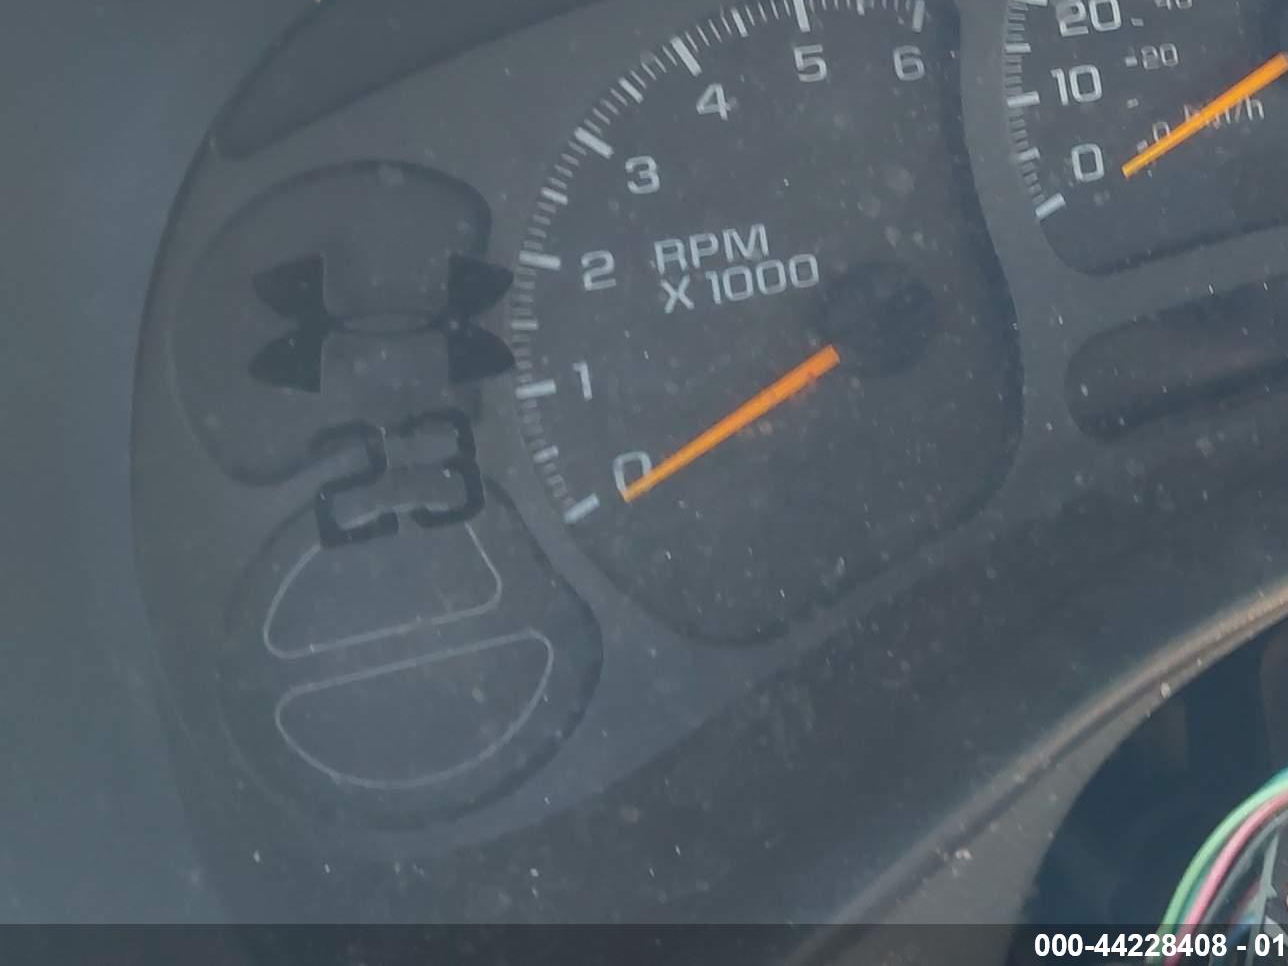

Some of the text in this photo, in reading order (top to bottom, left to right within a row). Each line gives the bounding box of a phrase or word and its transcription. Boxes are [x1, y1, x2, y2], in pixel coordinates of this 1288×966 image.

[793, 44, 827, 83] 5
[893, 45, 925, 82] 6
[696, 83, 729, 121] 4
[1050, 65, 1103, 106] 10
[624, 156, 660, 195] 3
[1071, 144, 1106, 183] 0
[653, 223, 770, 275] RPM
[581, 250, 617, 292] 2
[660, 253, 820, 314] X 1000
[572, 361, 593, 400] 1
[612, 451, 653, 498] 0
